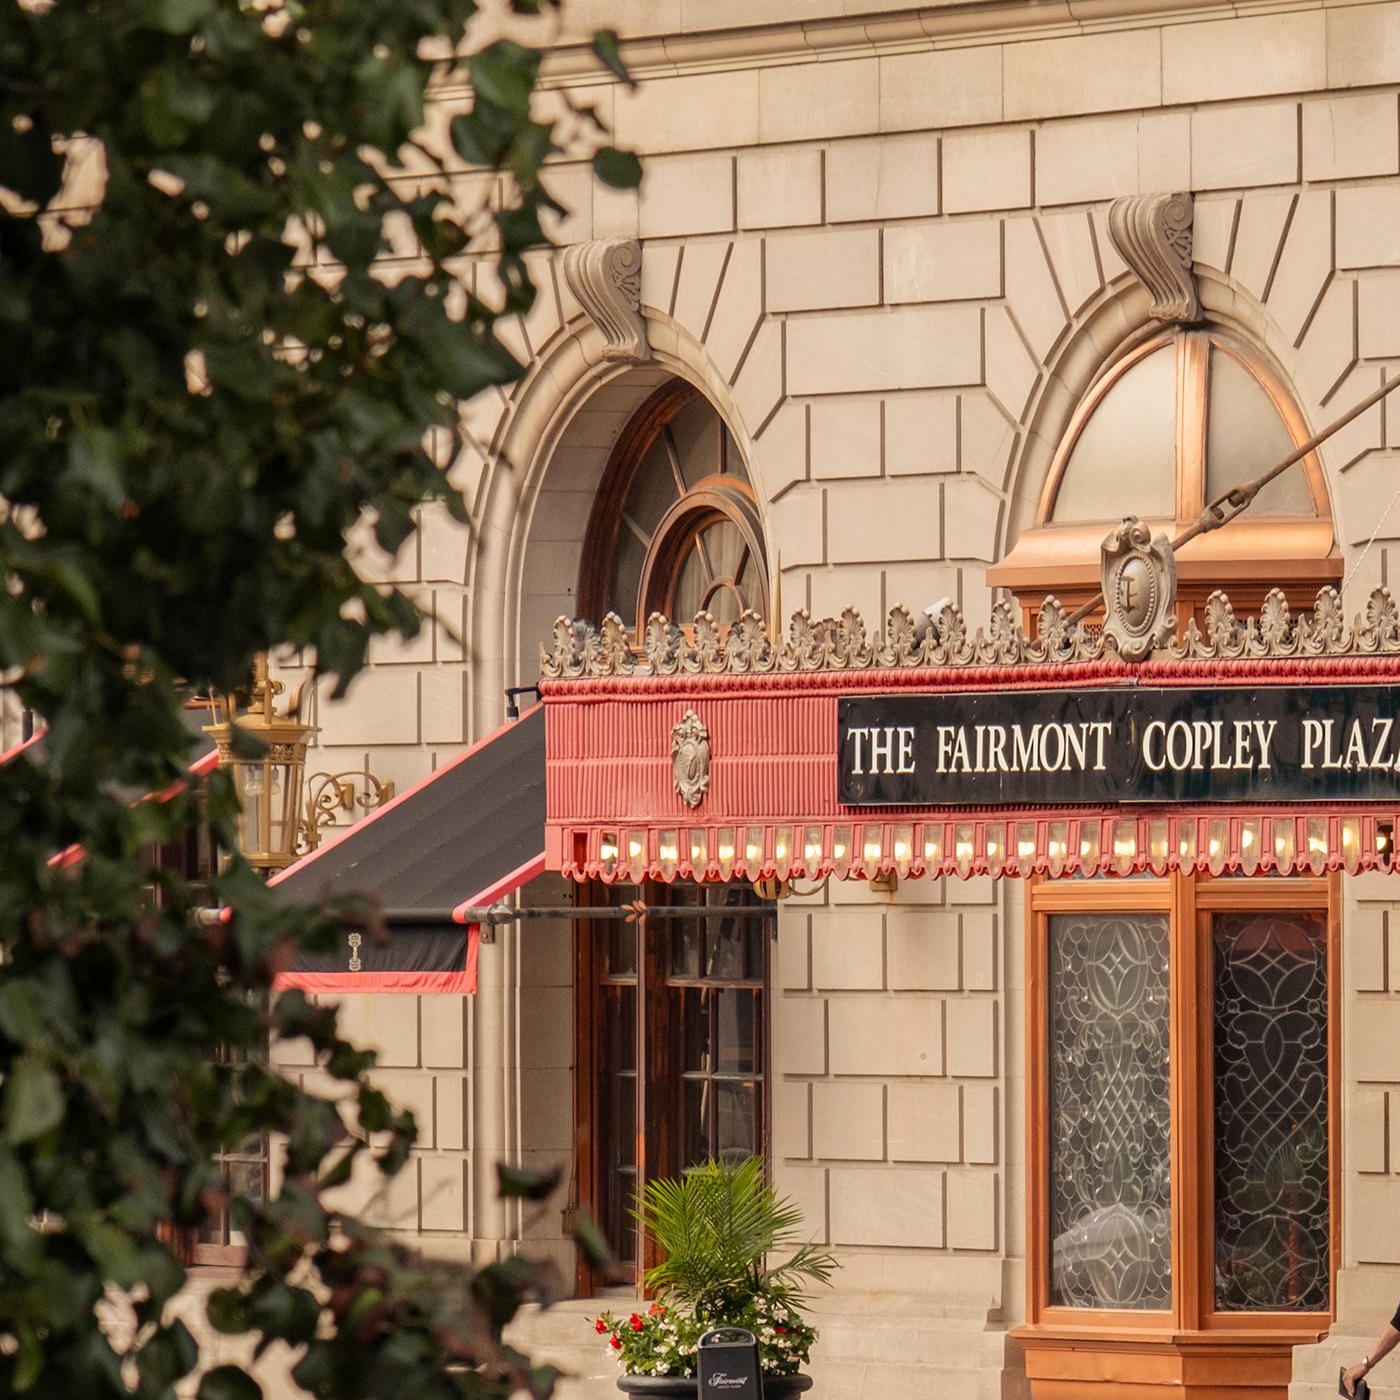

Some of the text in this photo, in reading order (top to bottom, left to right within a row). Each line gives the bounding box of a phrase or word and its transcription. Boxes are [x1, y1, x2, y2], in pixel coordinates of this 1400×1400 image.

[846, 726, 916, 775] THE
[935, 720, 1112, 773] FAIRMONT
[1142, 719, 1278, 771] COPLEY
[708, 1372, 747, 1387] Fairmont
